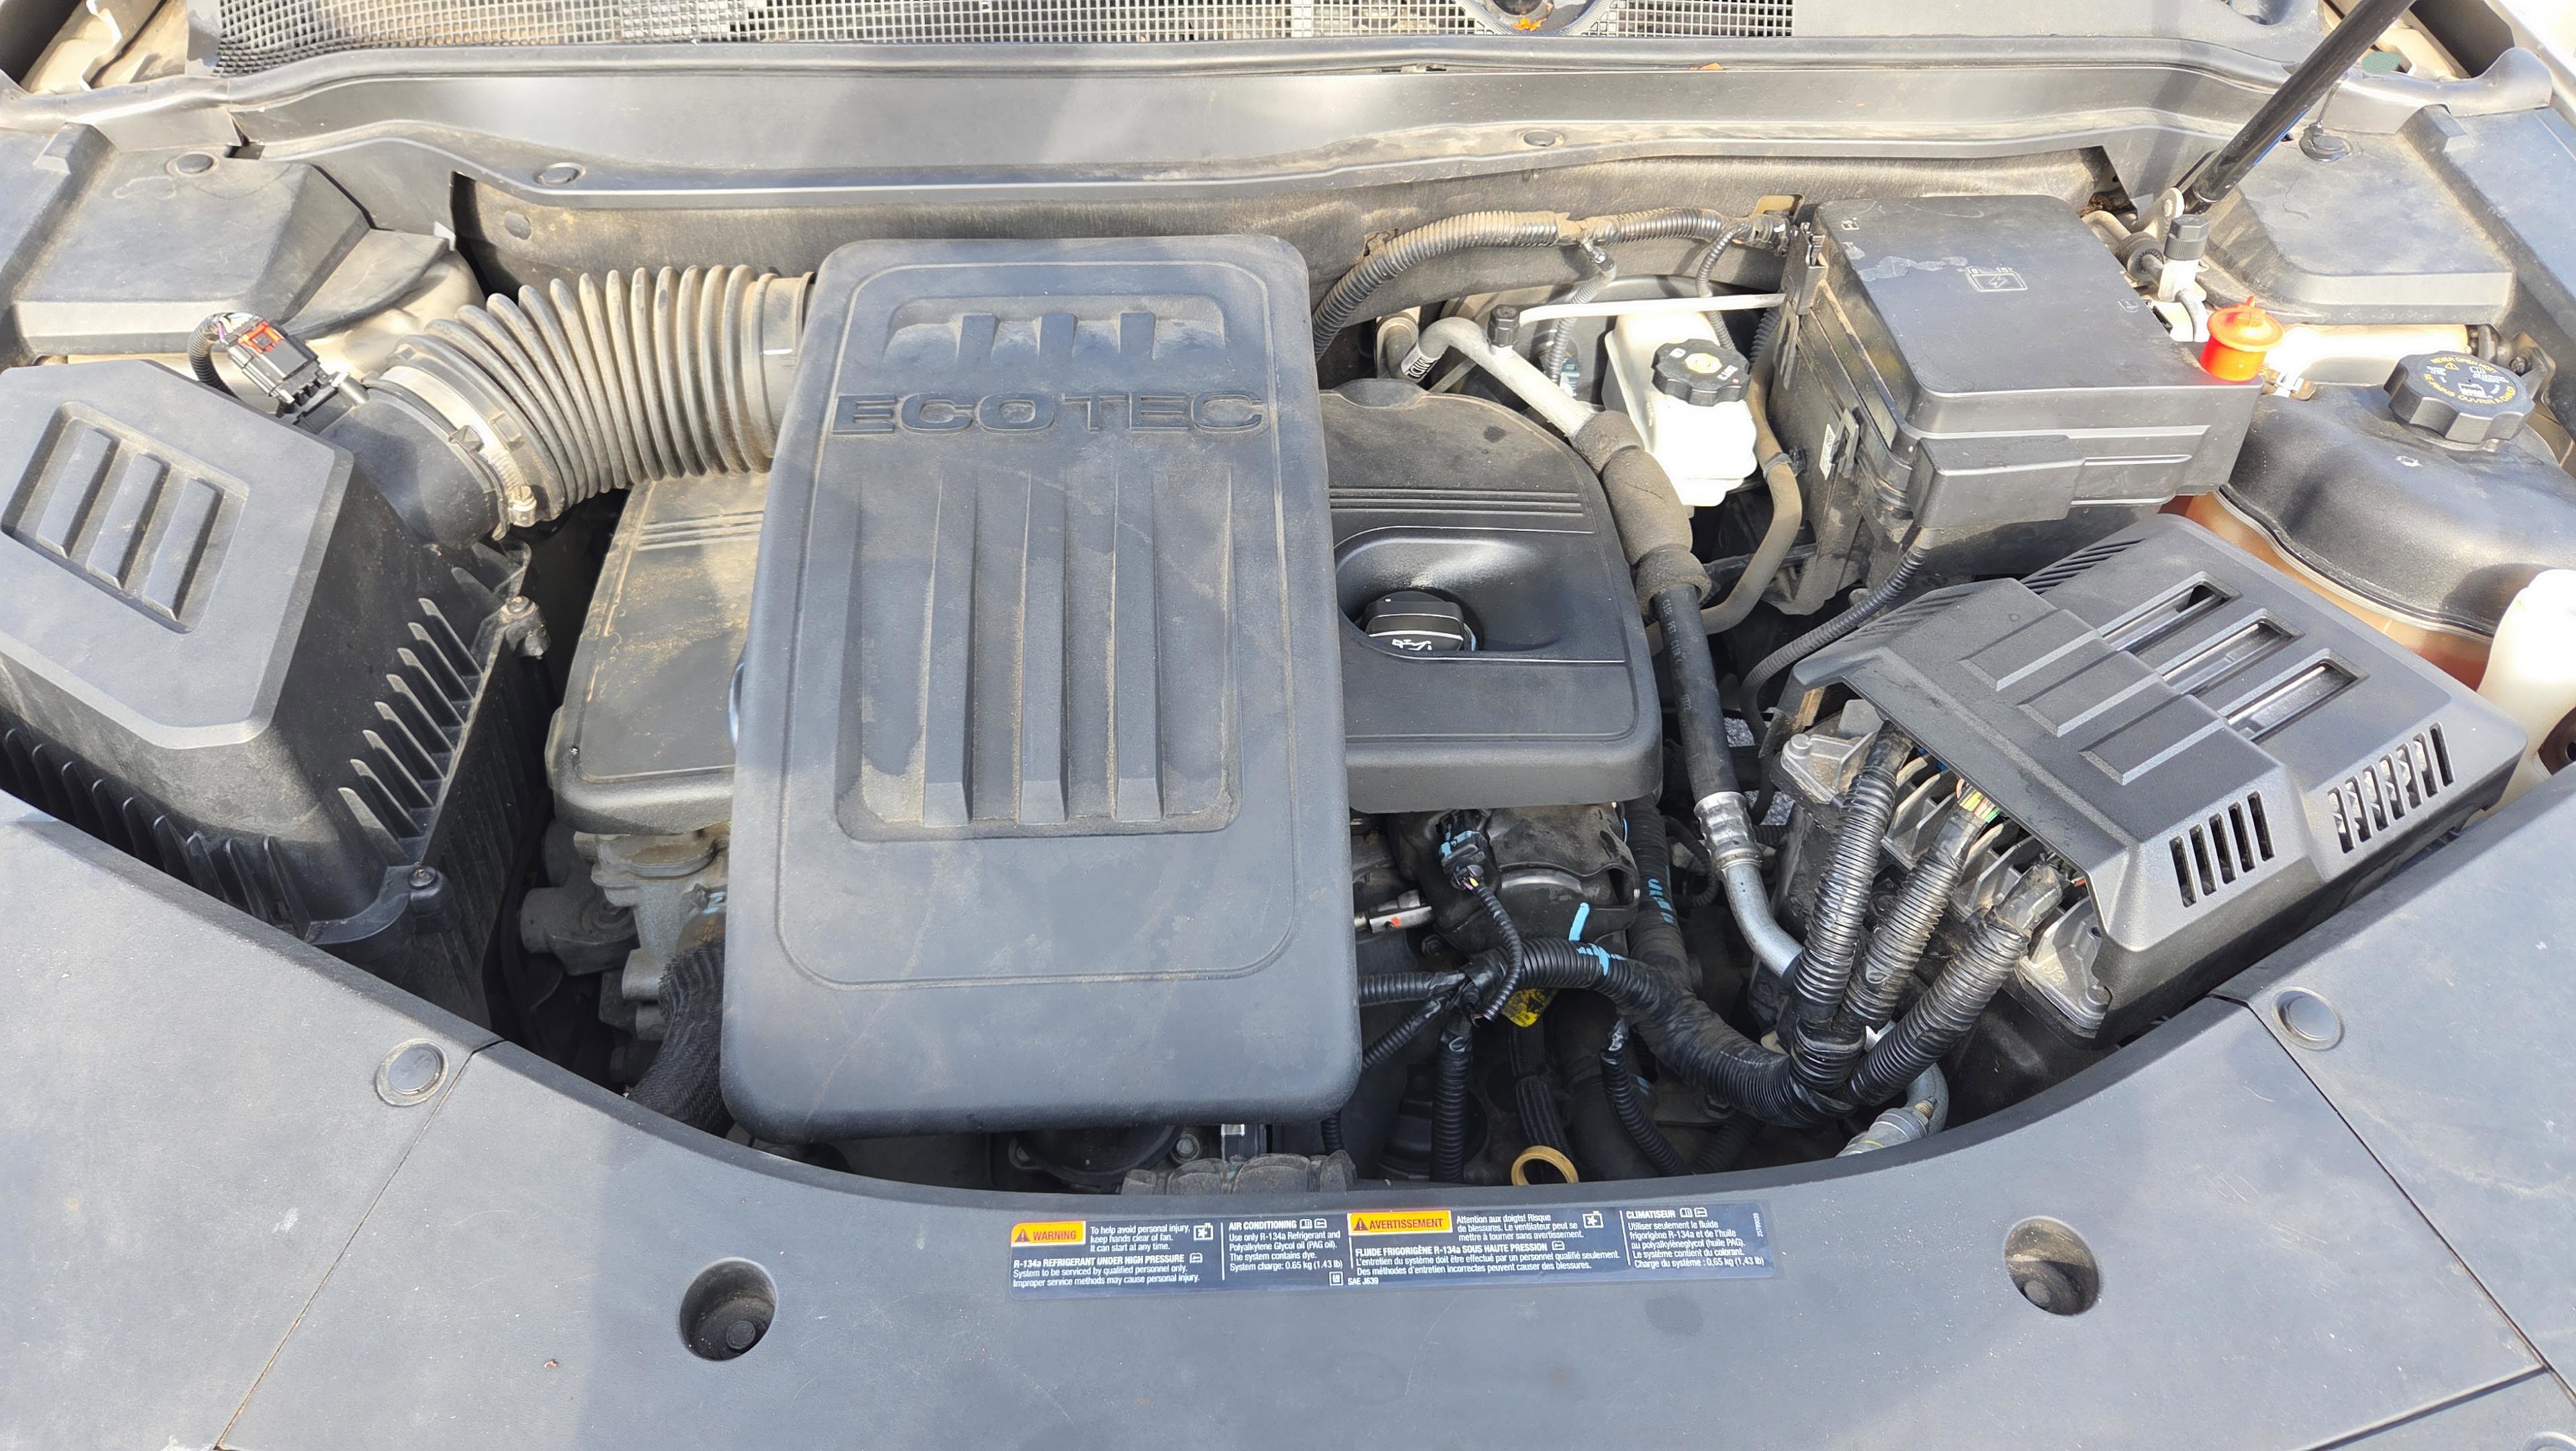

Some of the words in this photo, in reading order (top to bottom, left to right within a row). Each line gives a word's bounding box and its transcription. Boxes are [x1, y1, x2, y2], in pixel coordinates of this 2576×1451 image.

[832, 392, 1262, 435] ECOTEC
[1457, 1215, 1487, 1224] Attention
[1528, 1213, 1551, 1224] Risque
[1626, 1210, 1675, 1219] CLIMATISEUR
[1091, 1226, 1099, 1235] To
[1102, 1225, 1115, 1236] help
[1117, 1225, 1136, 1234] avoid
[1138, 1225, 1167, 1235] personal
[1229, 1221, 1242, 1230] AIR
[1244, 1221, 1296, 1230] CONDITIONING
[1369, 1219, 1443, 1230] AVERTISSEMENT
[1458, 1223, 1467, 1232] de
[1468, 1223, 1502, 1232] blessures.
[1505, 1223, 1512, 1231] Le
[1514, 1222, 1550, 1231] ventilateur
[1553, 1221, 1567, 1232] peut
[1628, 1221, 1652, 1230] Utiliser
[1654, 1221, 1689, 1230] seulement
[1691, 1221, 1698, 1229] le
[1700, 1220, 1718, 1229] fluide
[1033, 1231, 1077, 1241] WARNING
[1091, 1235, 1107, 1245] keep
[1110, 1234, 1130, 1243] hands
[1133, 1233, 1150, 1242] clear
[1152, 1233, 1158, 1242] of
[1160, 1233, 1172, 1241] fan.
[1229, 1233, 1242, 1241] Use
[1244, 1232, 1258, 1243] only
[1260, 1231, 1286, 1241] R-134a
[1288, 1231, 1326, 1241] Refrigerant
[1328, 1230, 1340, 1239] and
[1459, 1233, 1481, 1241] mettre
[1489, 1232, 1514, 1241] tourner
[1534, 1230, 1583, 1239] avertissement.
[1669, 1230, 1694, 1239] R-134a
[1696, 1230, 1703, 1238] et
[1705, 1229, 1713, 1238] de
[1091, 1244, 1095, 1252] It
[1112, 1243, 1127, 1252] start
[1129, 1243, 1136, 1251] at
[1138, 1245, 1151, 1253] any
[1153, 1242, 1170, 1251] time.
[1230, 1242, 1273, 1254] Polyalkylene
[1275, 1241, 1295, 1252] Glycol
[1297, 1241, 1305, 1249] oil
[1307, 1241, 1323, 1251] (PAG
[1706, 1239, 1724, 1249] (huile
[1727, 1238, 1745, 1249] PAG).
[1356, 1247, 1381, 1257] FLUIDE
[1434, 1245, 1461, 1254] R-134a
[1463, 1245, 1483, 1254] SOUS
[1485, 1243, 1508, 1253] HAUTE
[1511, 1243, 1547, 1252] PRESSION
[1632, 1250, 1641, 1258] Le
[1643, 1249, 1672, 1260] système
[1674, 1248, 1702, 1258] contient
[1704, 1248, 1712, 1257] du
[1714, 1247, 1744, 1256] colorant.
[1014, 1259, 1041, 1268] R-134a
[1044, 1257, 1095, 1267] REFRIGERANT
[1097, 1256, 1123, 1265] UNDER
[1125, 1256, 1143, 1264] HIGH
[1146, 1254, 1184, 1264] PRESSURE
[1230, 1253, 1242, 1262] The
[1244, 1252, 1269, 1263] system
[1271, 1251, 1300, 1260] contains
[1302, 1251, 1317, 1261] dye.
[1394, 1256, 1403, 1265] du
[1405, 1256, 1433, 1266] système
[1436, 1255, 1448, 1264] doit
[1466, 1254, 1493, 1263] effectué
[1496, 1256, 1507, 1264] par
[1520, 1252, 1553, 1263] personnel
[1555, 1251, 1580, 1262] qualifié
[1582, 1250, 1620, 1260] seulement.
[1230, 1262, 1256, 1272] System
[1258, 1261, 1284, 1272] charge:
[1285, 1261, 1301, 1270] 0.65
[1303, 1260, 1312, 1271] kg
[1314, 1260, 1332, 1270] (1.43
[1357, 1267, 1371, 1276] Des
[1373, 1266, 1406, 1275] méthodes
[1447, 1264, 1485, 1273] incorrectes
[1487, 1263, 1515, 1274] peuvent
[1542, 1262, 1554, 1271] des
[1557, 1261, 1591, 1270] blessures.
[1635, 1259, 1659, 1270] Charge
[1661, 1259, 1670, 1268] du
[1672, 1258, 1700, 1269] système
[1724, 1258, 1733, 1268] kg
[1014, 1268, 1040, 1279] System
[1042, 1268, 1048, 1277] to
[1049, 1268, 1059, 1276] be
[1061, 1267, 1091, 1276] serviced
[1093, 1266, 1102, 1277] by
[1104, 1266, 1134, 1276] qualified
[1136, 1264, 1169, 1276] personnel
[1172, 1264, 1187, 1274] only.
[1014, 1278, 1045, 1289] Improper
[1047, 1277, 1072, 1286] service
[1074, 1276, 1105, 1286] methods
[1107, 1278, 1121, 1286] may
[1147, 1274, 1177, 1285] personal
[1179, 1274, 1199, 1284] injury.
[1348, 1277, 1361, 1286] SAE
